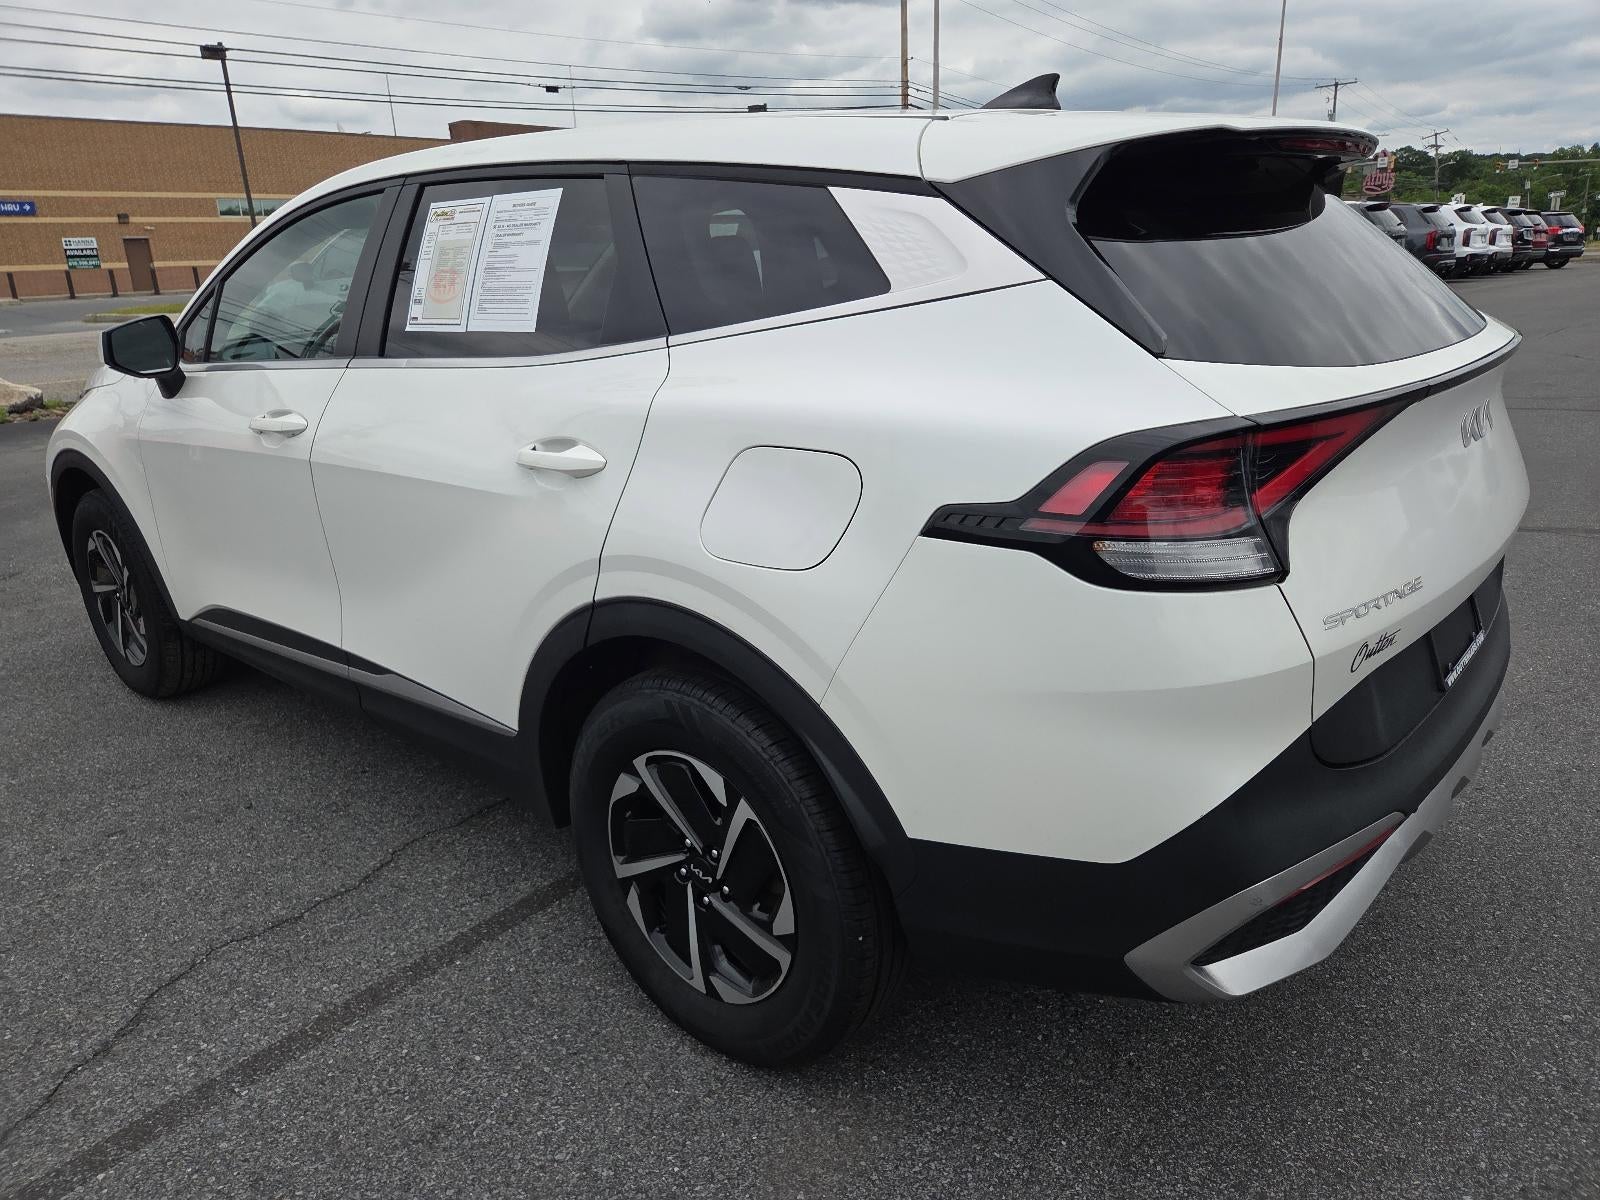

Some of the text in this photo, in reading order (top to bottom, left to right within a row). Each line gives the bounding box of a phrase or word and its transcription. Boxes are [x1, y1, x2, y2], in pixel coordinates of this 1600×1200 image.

[1363, 169, 1396, 188] Arby's
[1323, 576, 1424, 631] SPORTAGE
[1351, 628, 1402, 673] Outten
